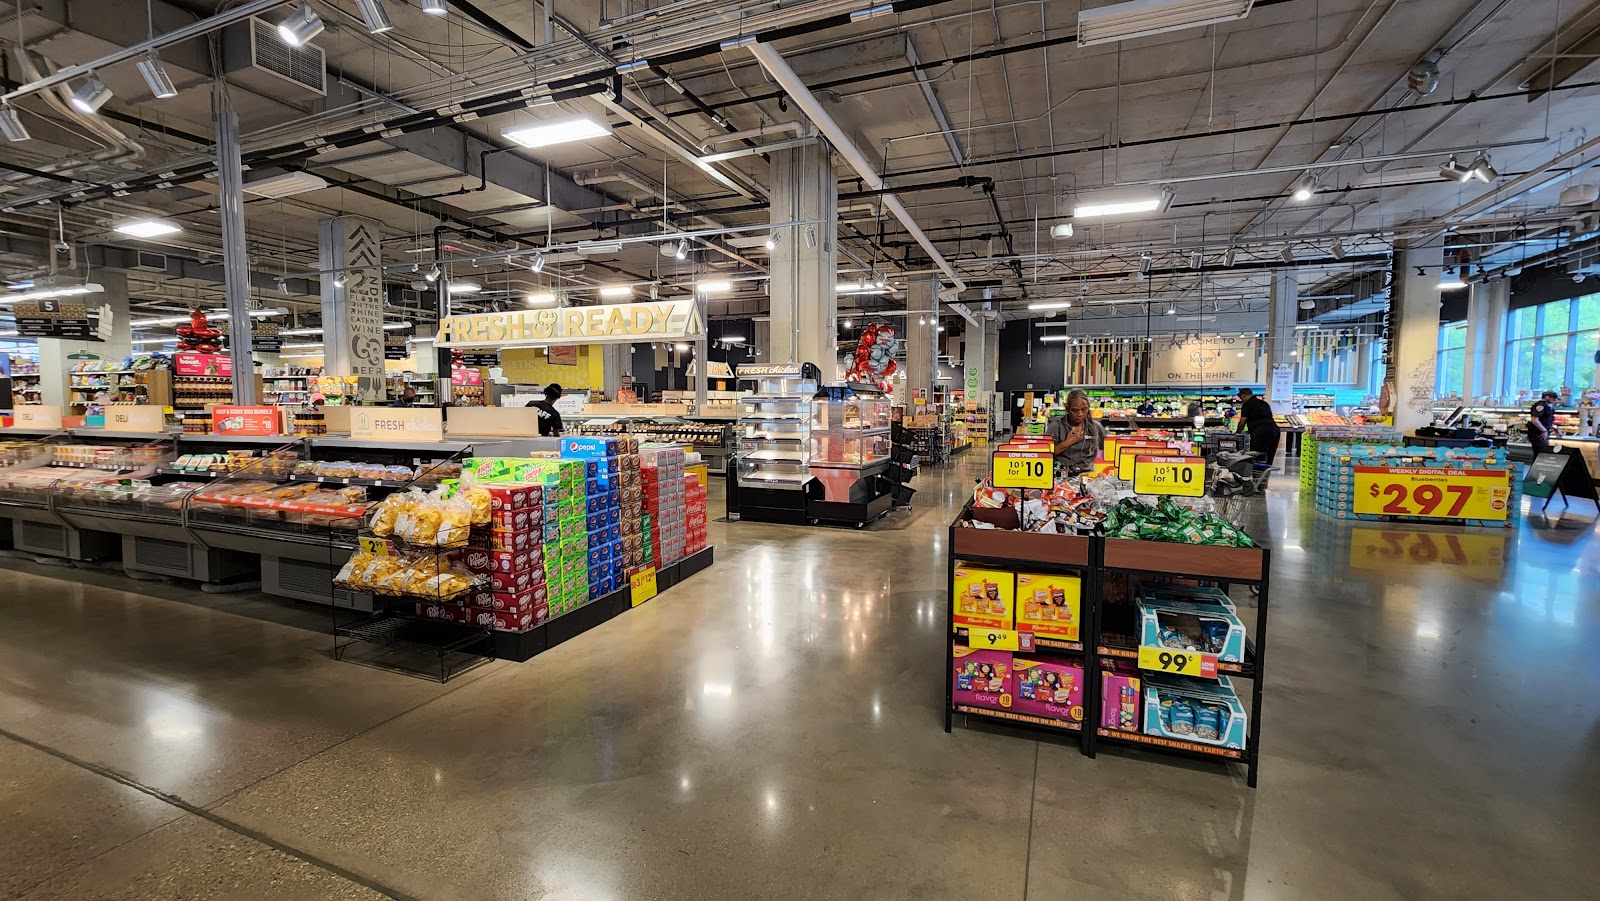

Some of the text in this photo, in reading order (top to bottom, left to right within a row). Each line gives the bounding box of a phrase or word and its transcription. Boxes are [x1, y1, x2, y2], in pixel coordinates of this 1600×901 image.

[44, 301, 54, 312] 5
[249, 300, 258, 309] XIT
[350, 308, 380, 318] RHINE
[439, 304, 676, 343] FRESH & READY
[351, 324, 381, 335] WINE
[1189, 351, 1215, 368] Kroger
[352, 366, 383, 375] BEER
[738, 367, 769, 375] FRESH
[768, 365, 800, 374] chicken
[22, 413, 33, 421] DELI
[115, 414, 129, 422] DELI
[374, 419, 405, 431] FRESH
[578, 443, 597, 452] pepsi
[1008, 468, 1019, 476] for
[1154, 467, 1165, 475] 10
[975, 694, 998, 702] flavor
[1045, 704, 1070, 713] flavor
[977, 708, 995, 716] GROW
[995, 710, 1006, 718] THE
[1020, 714, 1040, 723] SNACKS
[1122, 733, 1140, 741] GROW
[1141, 735, 1152, 743] THE
[1154, 737, 1167, 746] BEST
[1168, 739, 1192, 750] SNACKS
[1193, 744, 1203, 752] ON
[1204, 746, 1225, 756] EARTH
